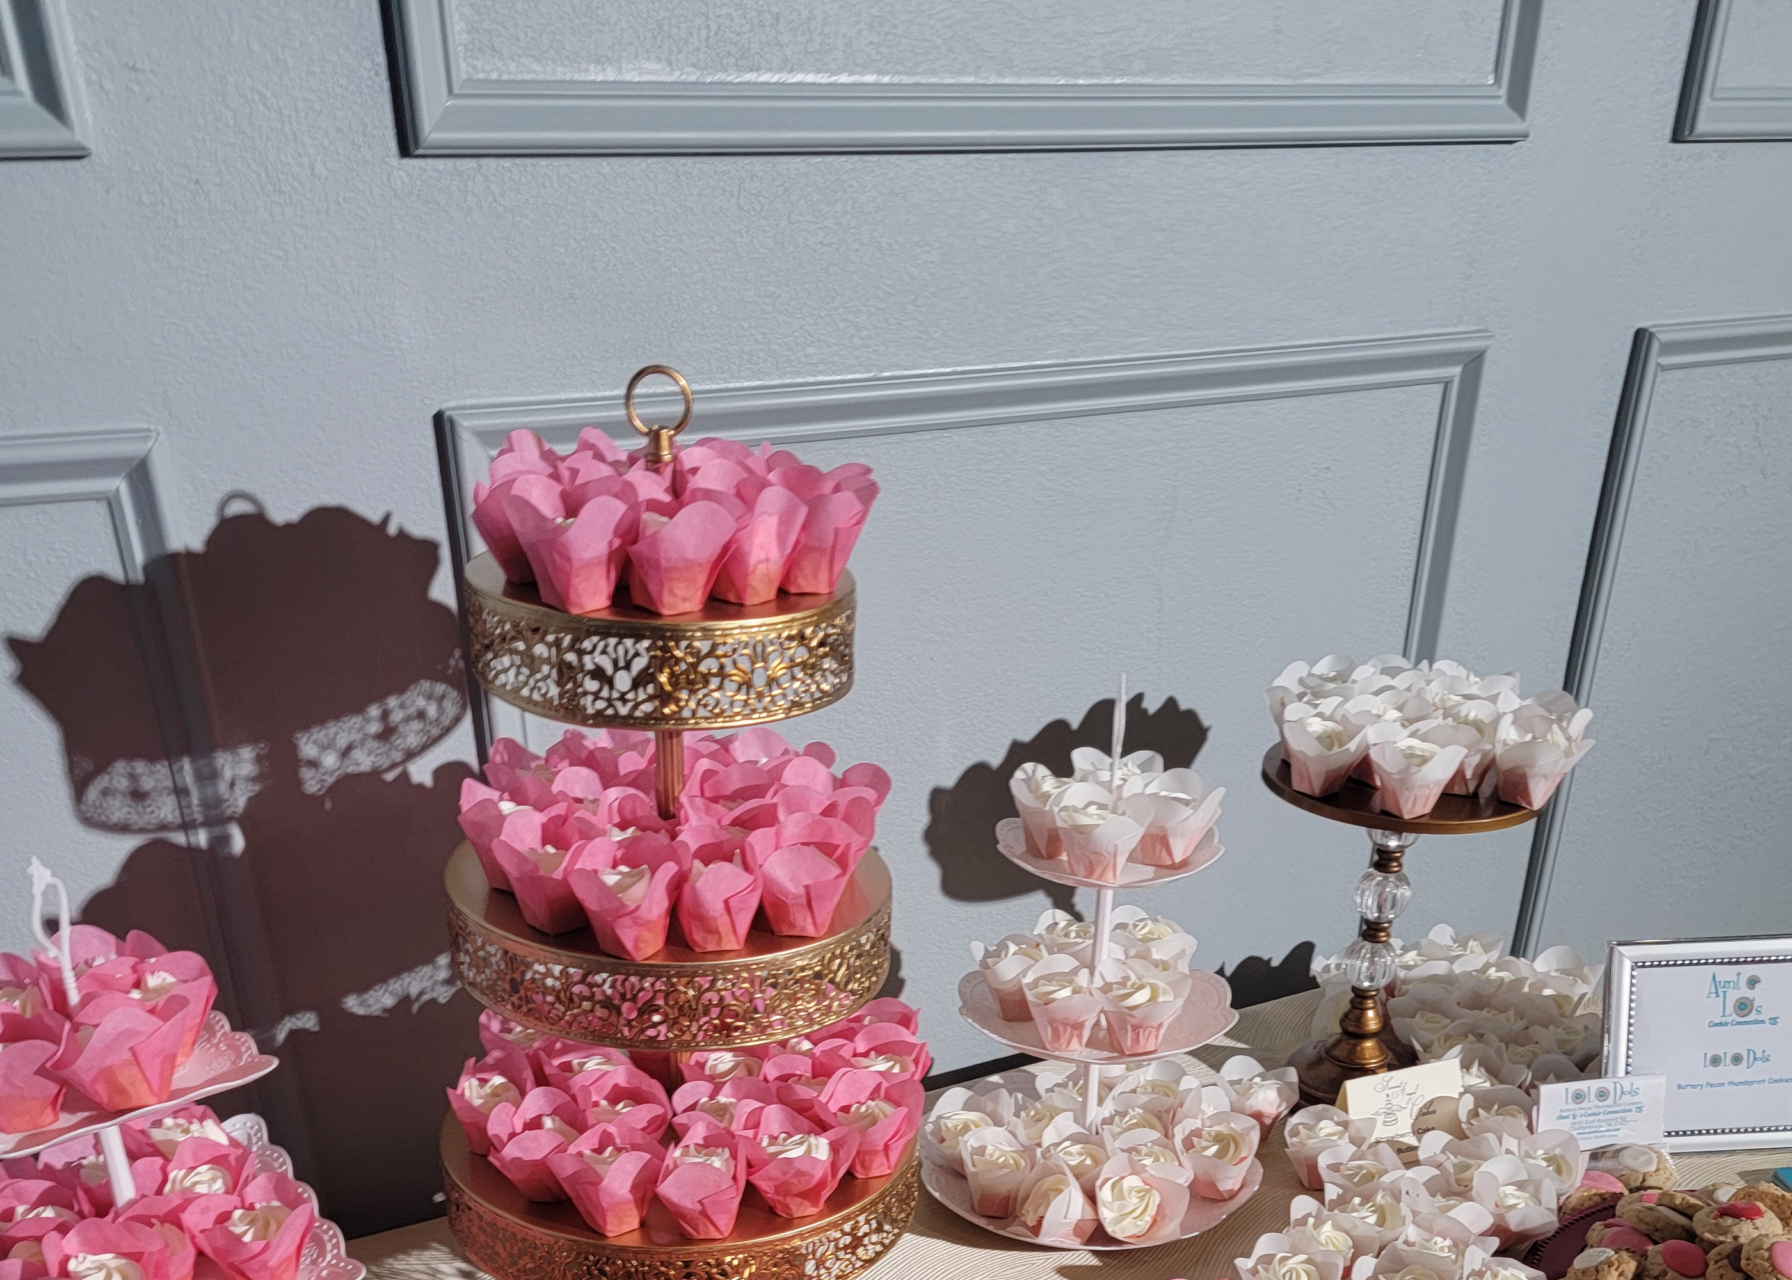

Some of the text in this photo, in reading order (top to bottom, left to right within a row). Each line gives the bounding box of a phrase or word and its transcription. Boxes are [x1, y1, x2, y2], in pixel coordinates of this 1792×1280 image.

[1706, 971, 1742, 998] Aunt
[1746, 1048, 1771, 1069] Dots
[1612, 1081, 1640, 1104] Dots
